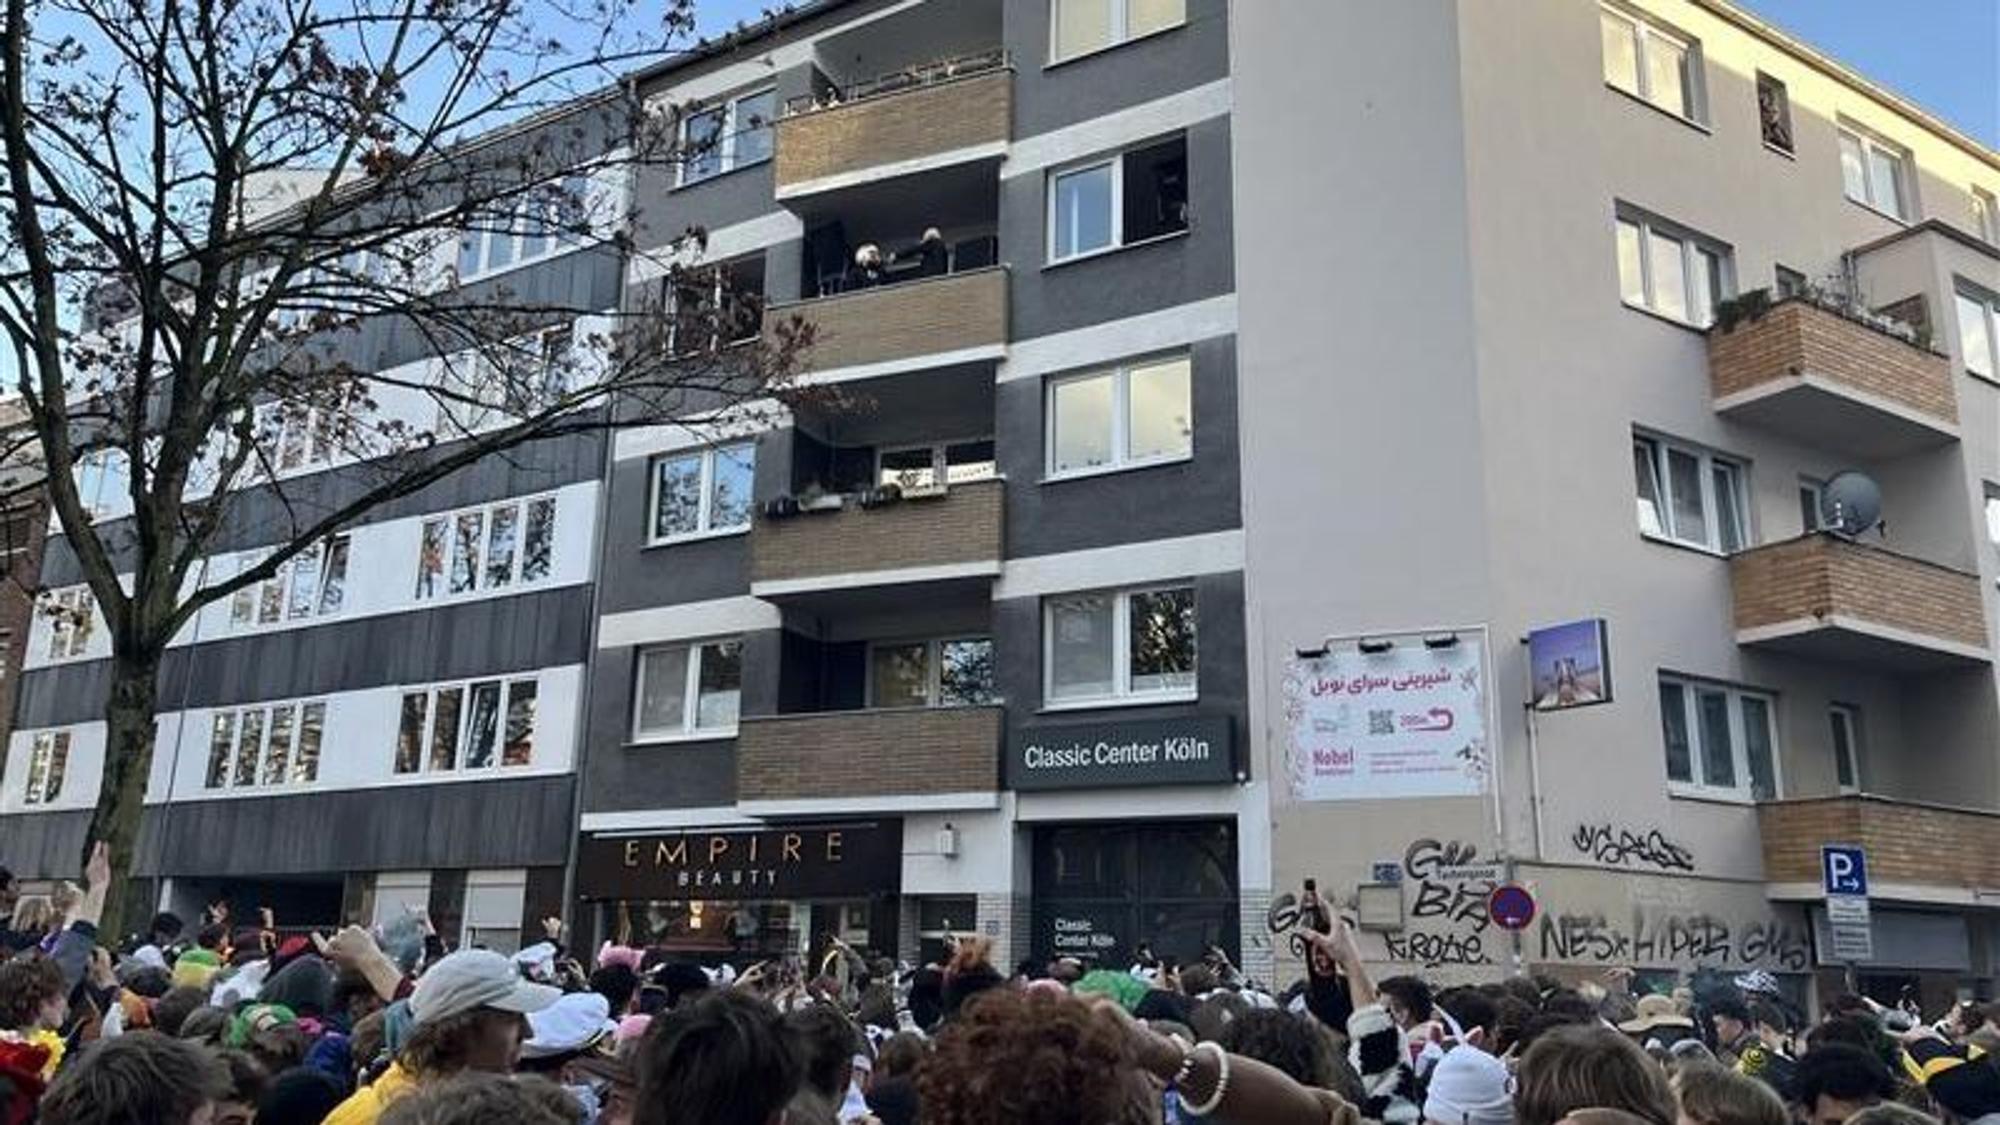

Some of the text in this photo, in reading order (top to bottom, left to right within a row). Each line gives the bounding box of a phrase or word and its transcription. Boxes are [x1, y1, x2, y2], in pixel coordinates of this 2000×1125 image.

[1025, 737, 1209, 768] Classic Center Köln
[624, 832, 842, 866] EMPIRE
[678, 869, 776, 886] BEAUTY
[1830, 852, 1852, 888] P
